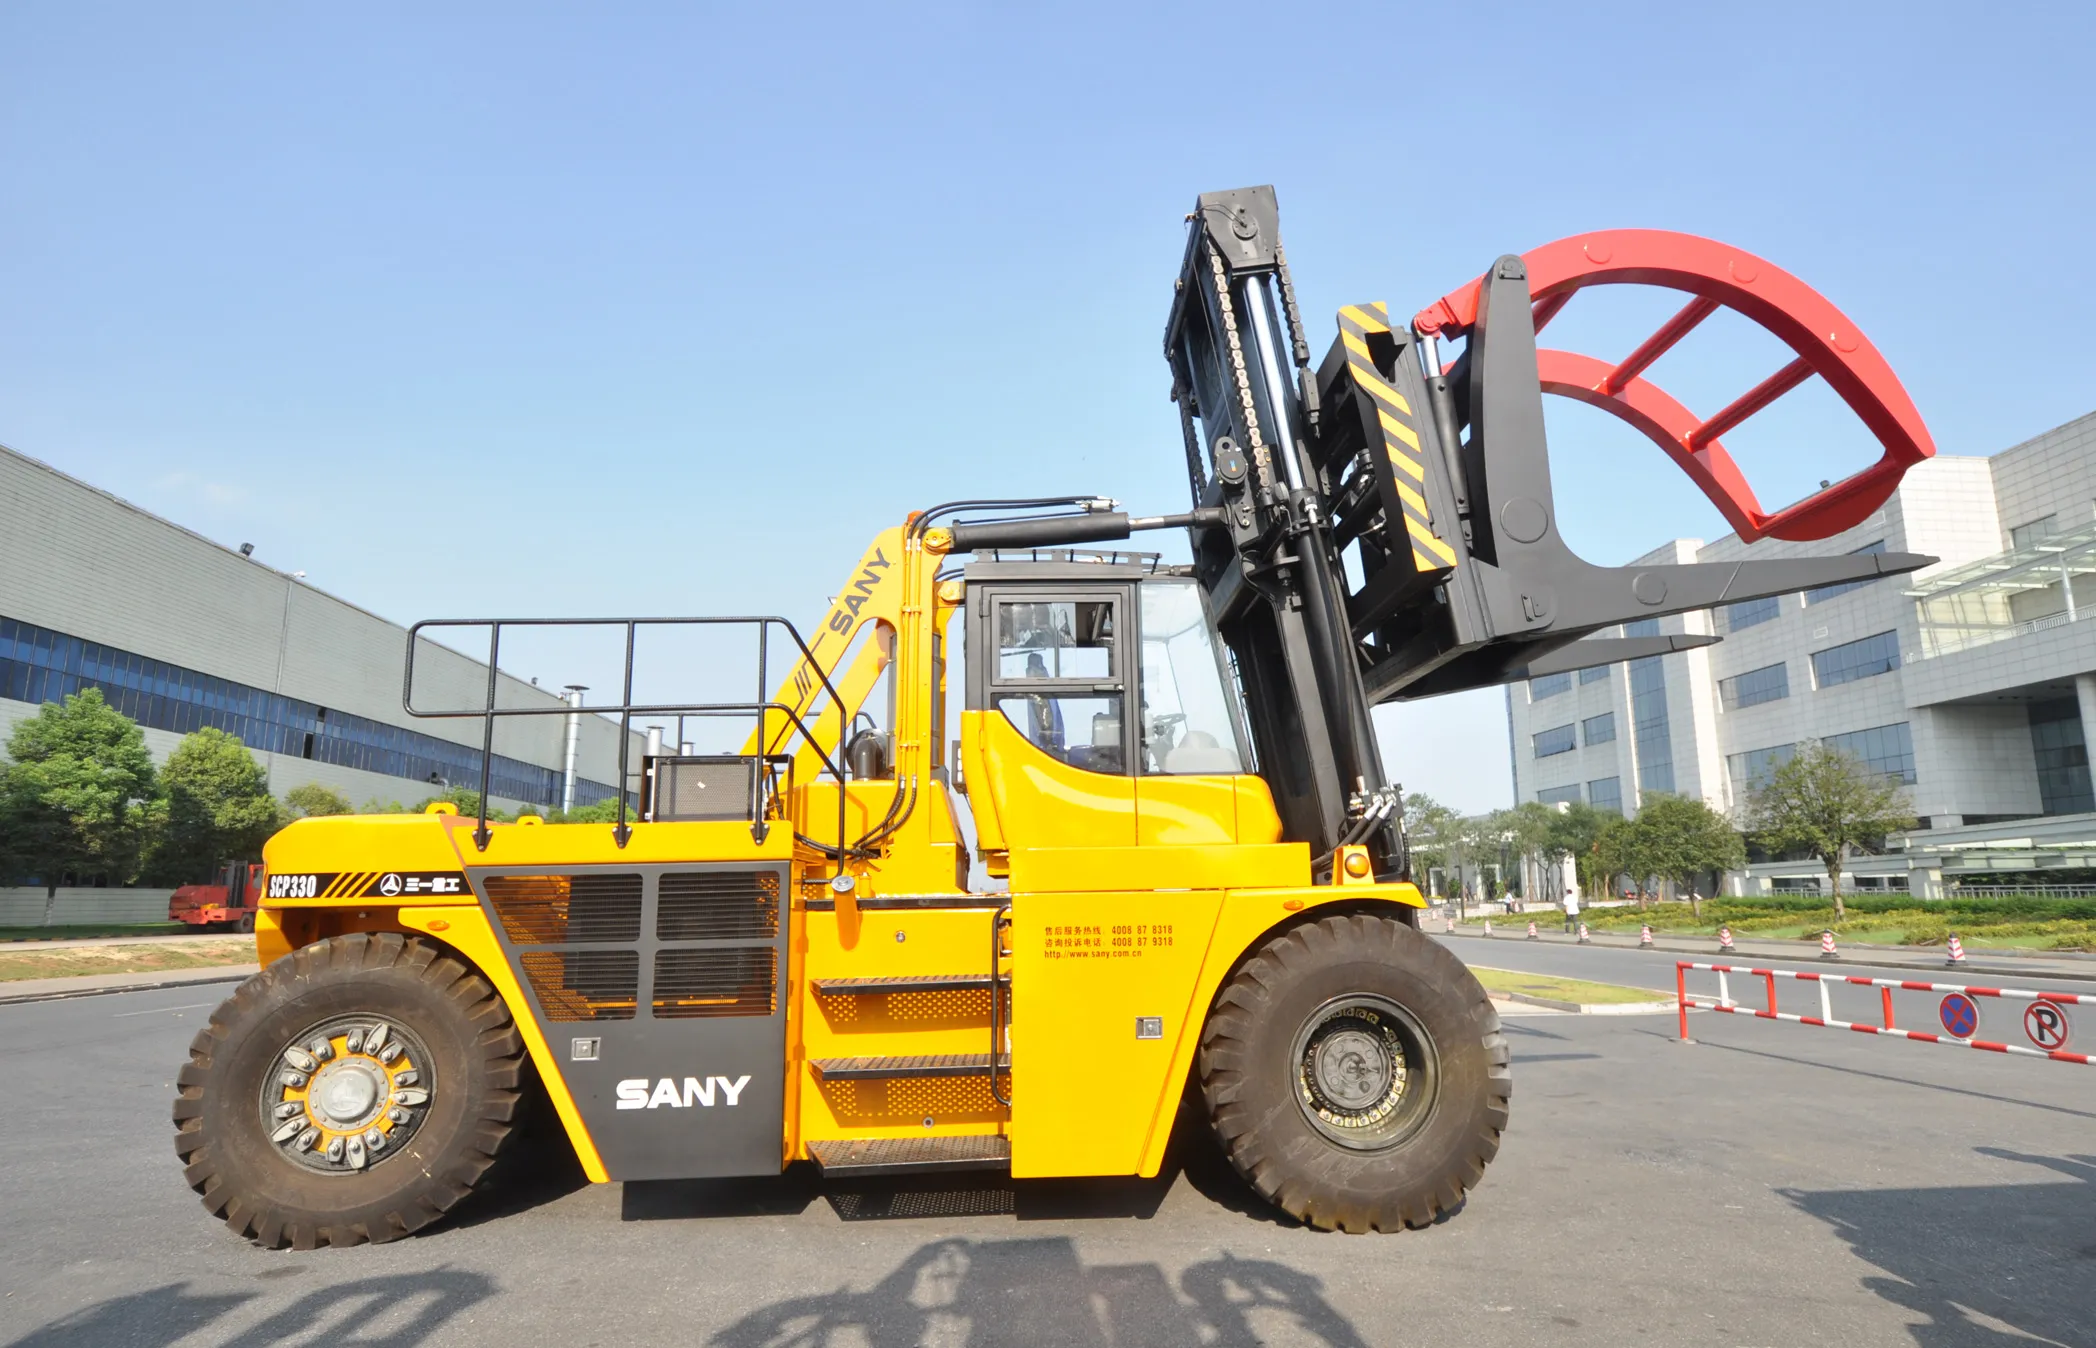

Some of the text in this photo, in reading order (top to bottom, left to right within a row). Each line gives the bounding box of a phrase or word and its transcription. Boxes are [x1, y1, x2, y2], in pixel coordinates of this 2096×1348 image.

[829, 547, 890, 636] SANY
[269, 875, 317, 898] SCP330
[1112, 925, 1132, 935] 4008
[1137, 925, 1147, 935] 87
[1152, 925, 1173, 935] 8318
[1112, 937, 1132, 947] 4008
[1137, 937, 1147, 947] 87
[1152, 937, 1173, 947] 9318
[616, 1075, 752, 1110] SANY
